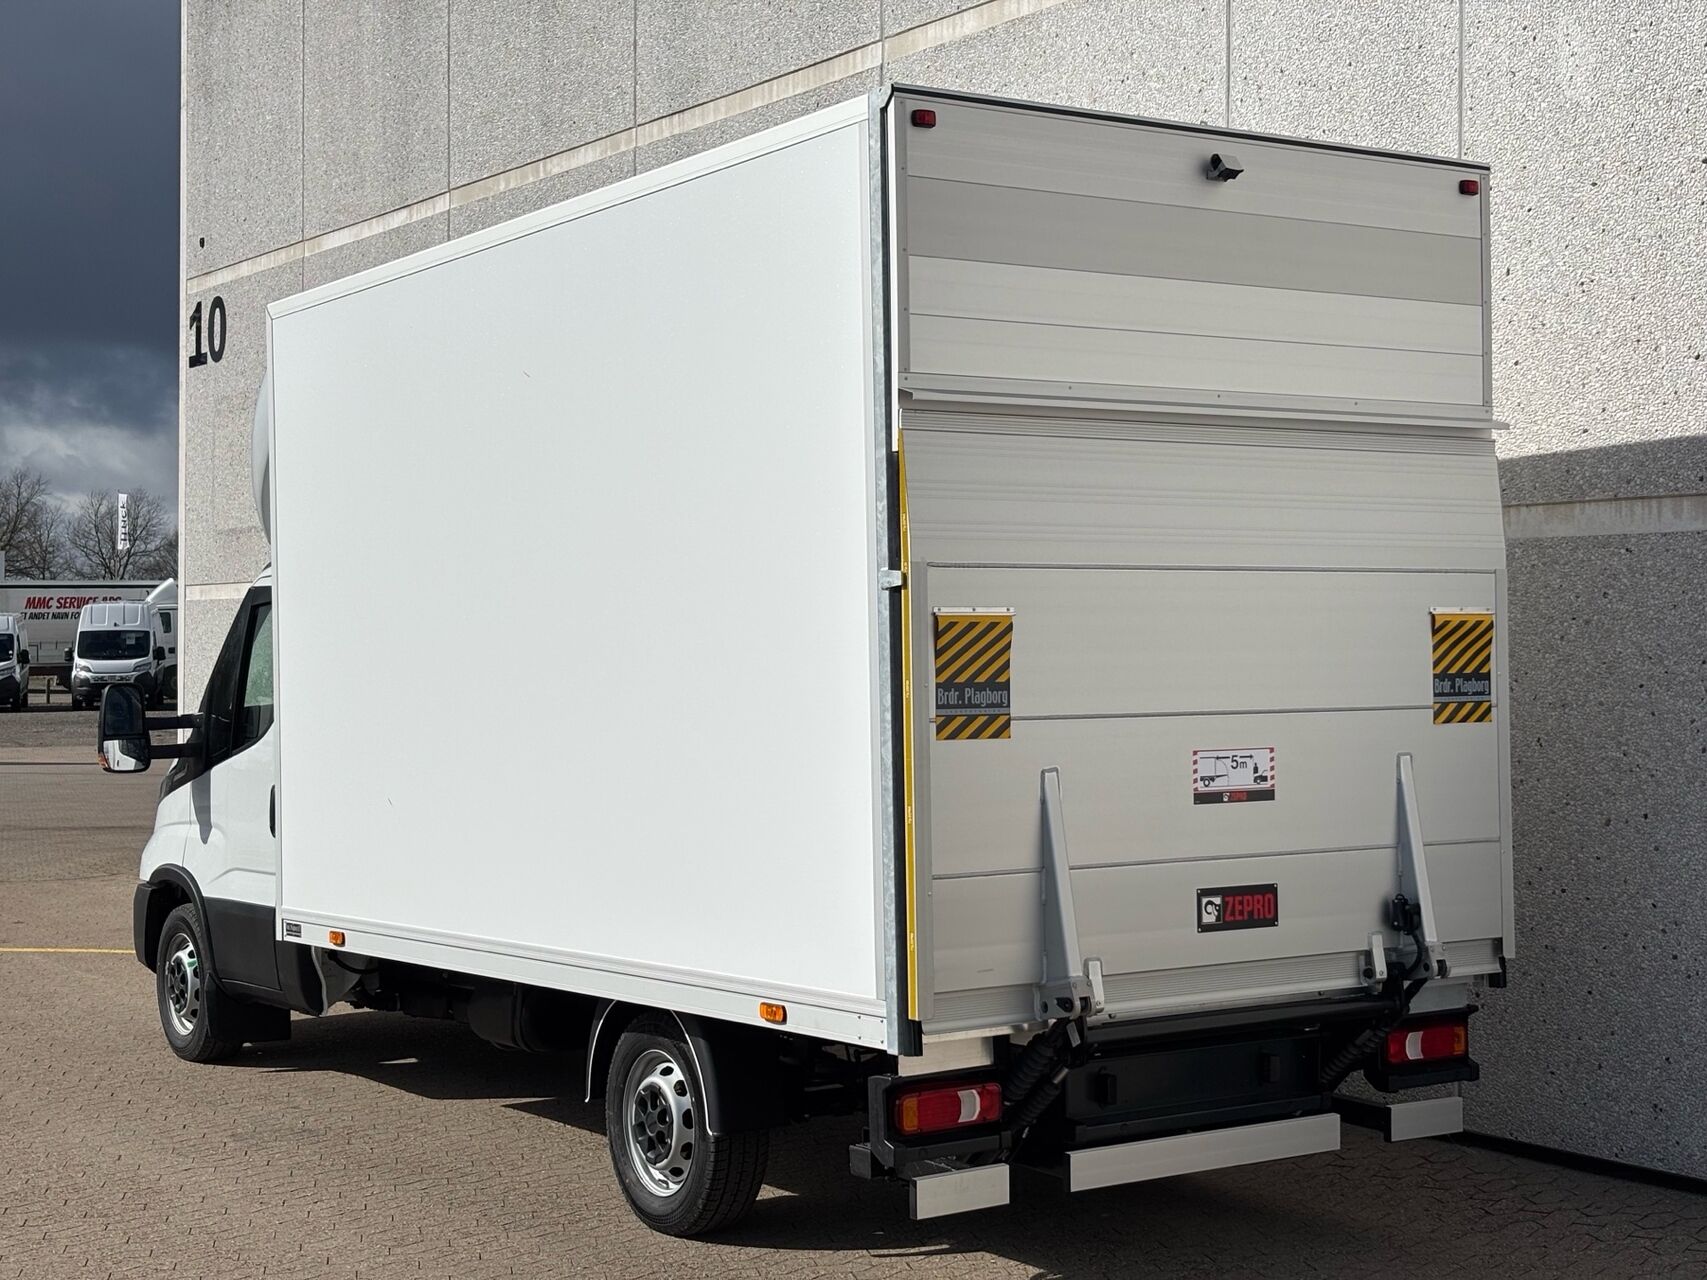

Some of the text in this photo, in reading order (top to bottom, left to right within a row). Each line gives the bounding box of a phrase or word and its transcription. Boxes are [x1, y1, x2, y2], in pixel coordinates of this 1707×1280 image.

[188, 295, 227, 368] 10
[24, 596, 54, 609] MMC
[20, 611, 28, 620] T
[28, 611, 51, 620] ANDET
[51, 611, 70, 620] NAVN
[1434, 677, 1489, 695] Brdr. Plagborg
[937, 687, 1008, 707] Brdr. Plagborg
[1223, 892, 1275, 921] ZEPRO
